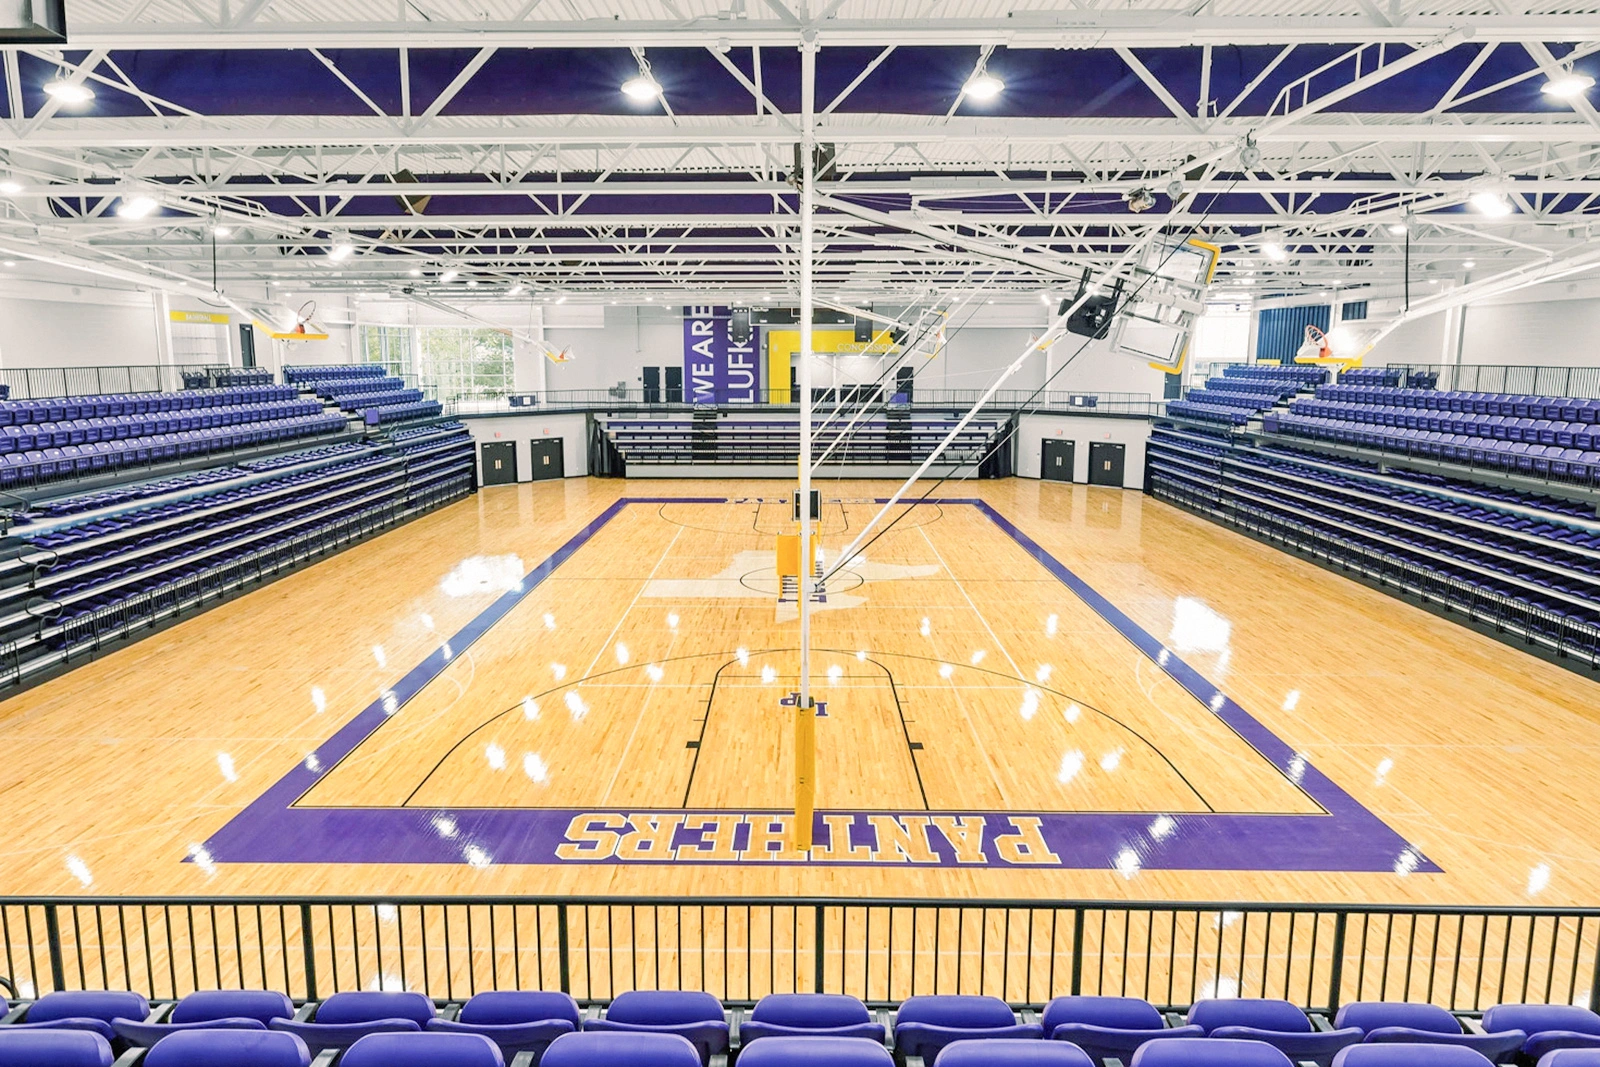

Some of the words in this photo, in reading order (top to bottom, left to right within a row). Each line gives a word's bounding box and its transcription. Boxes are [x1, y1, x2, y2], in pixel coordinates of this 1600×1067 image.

[691, 306, 714, 359] ARE
[727, 306, 755, 403] LUFK
[692, 363, 715, 403] WE
[554, 812, 1062, 865] PANTHERS
